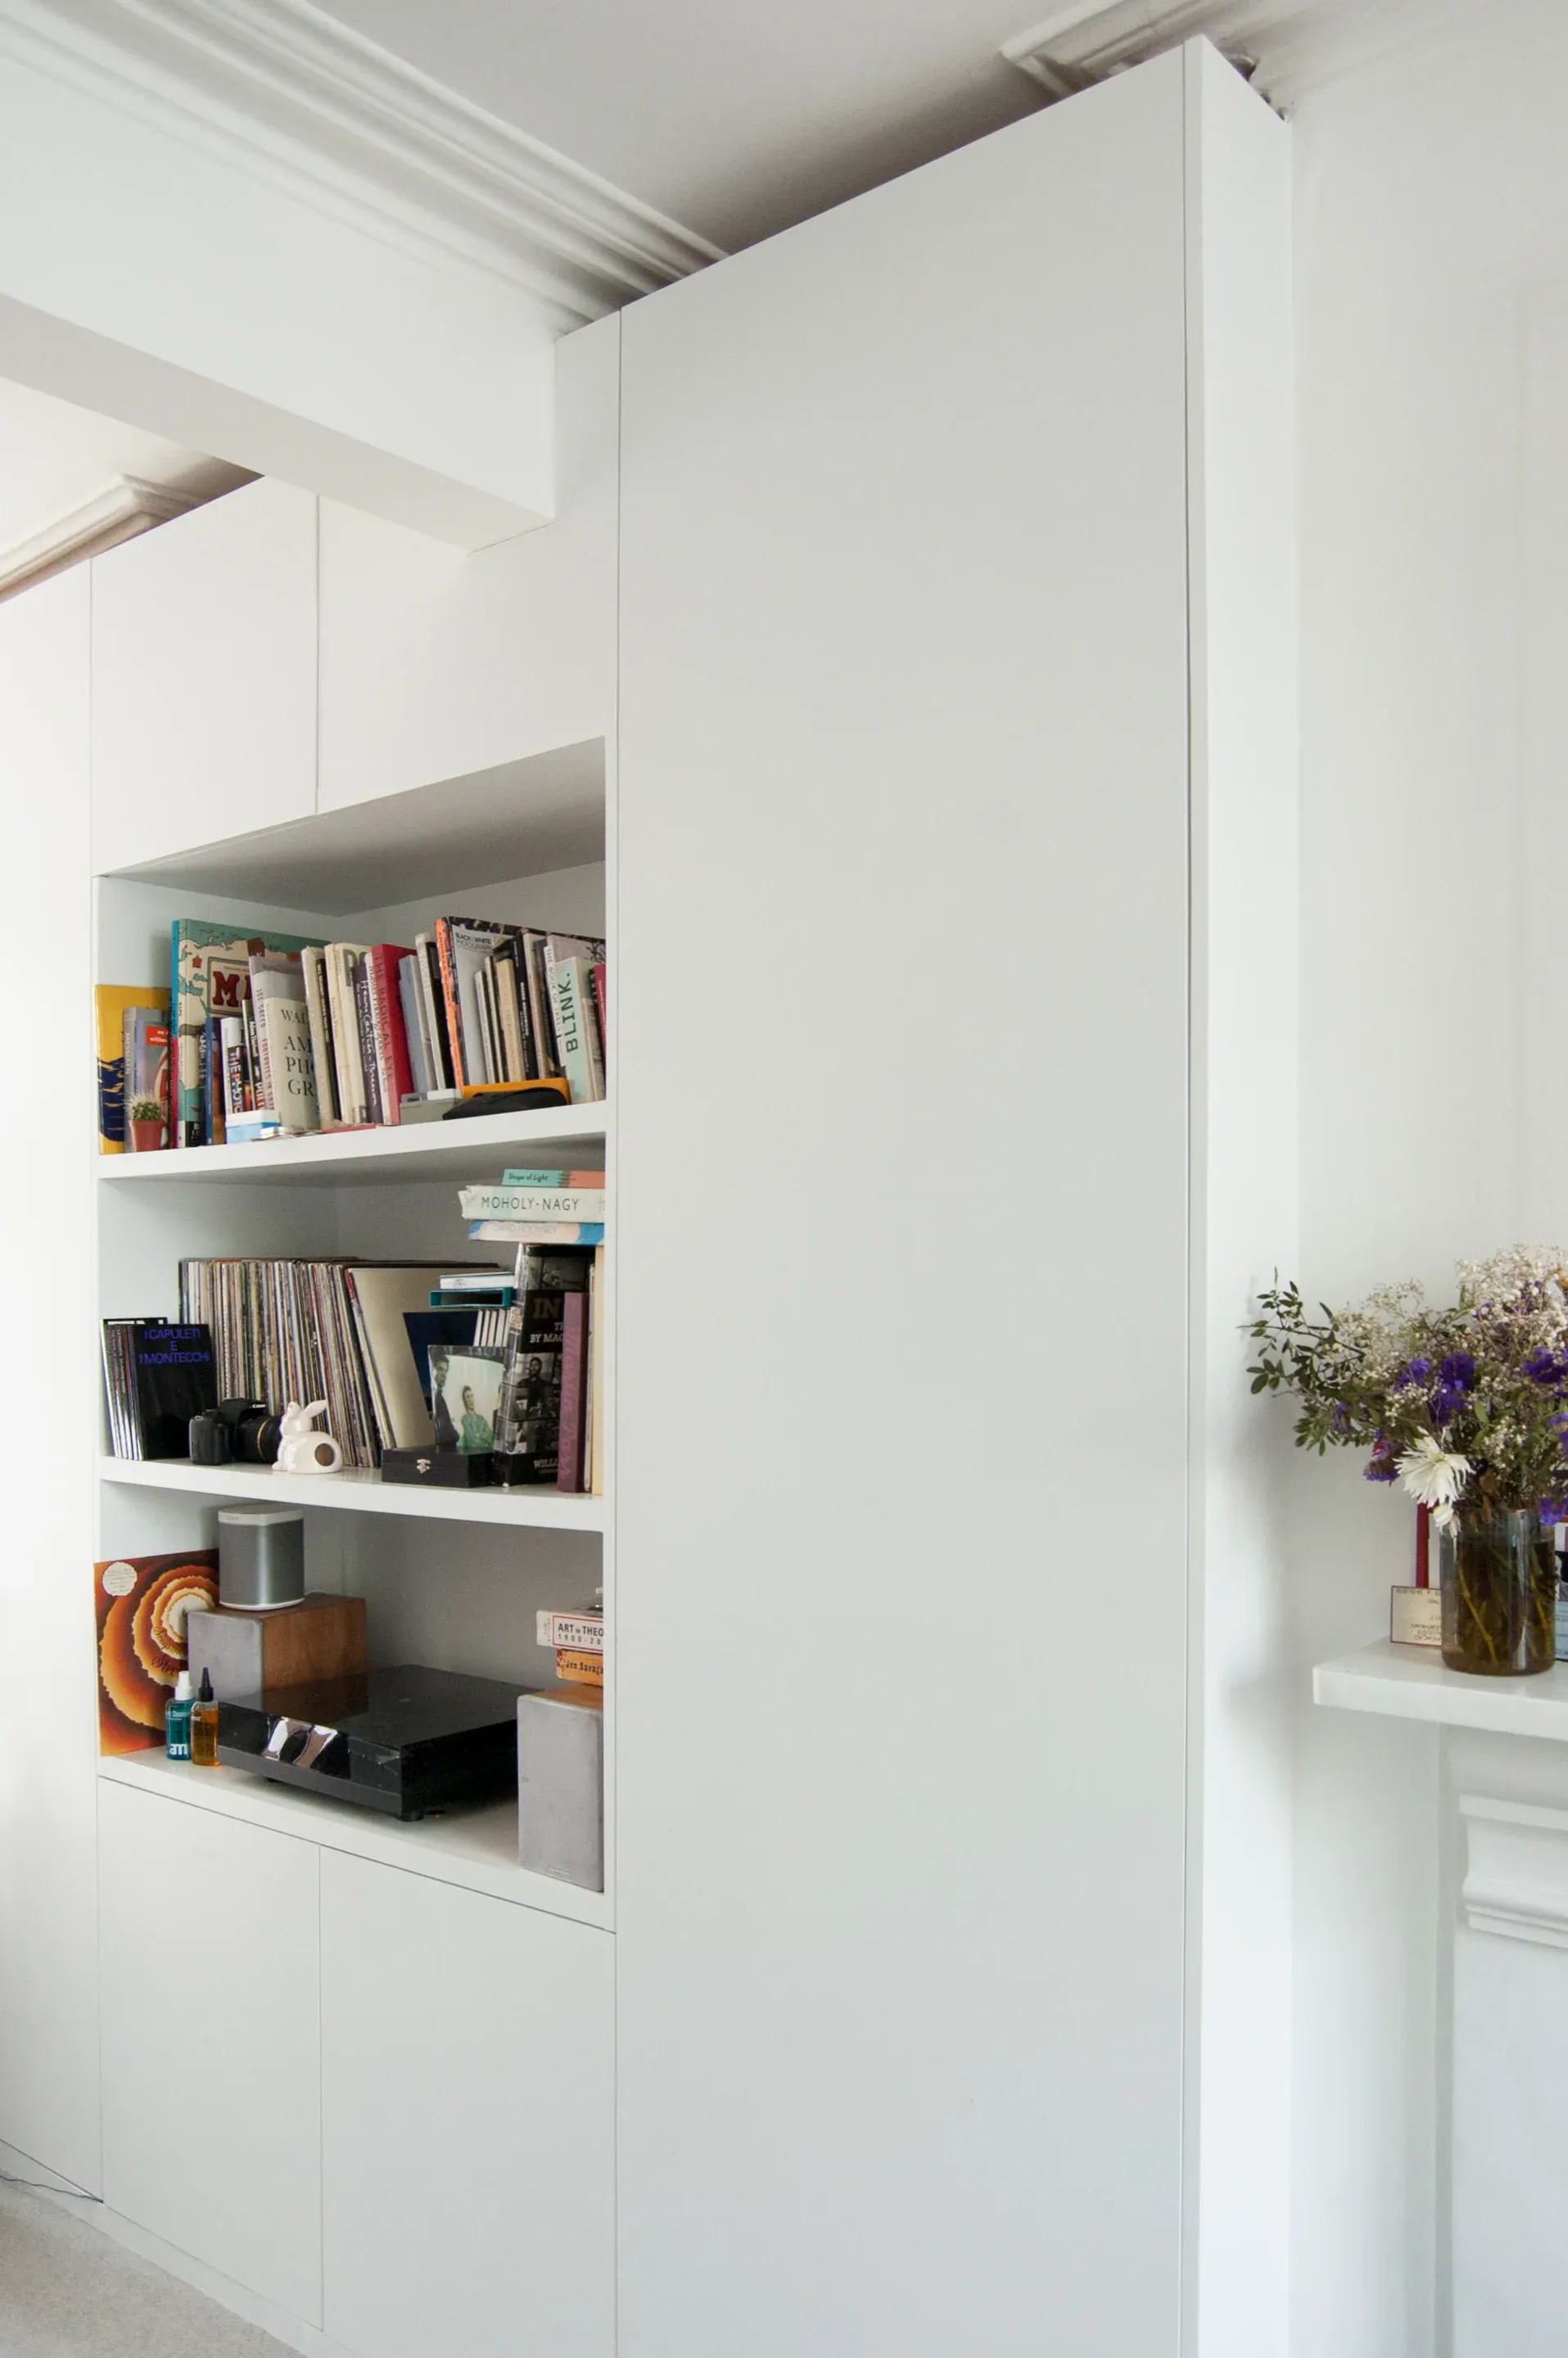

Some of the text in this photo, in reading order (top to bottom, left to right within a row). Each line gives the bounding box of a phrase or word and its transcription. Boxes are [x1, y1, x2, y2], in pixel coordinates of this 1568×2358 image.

[549, 967, 557, 990] BOOK
[374, 955, 395, 1082] THE RADICAL EYE
[228, 1047, 242, 1072] THE
[287, 1056, 315, 1075] PH
[508, 1173, 525, 1183] Shape
[534, 1174, 549, 1183] Light
[481, 1196, 580, 1211] MOHOLY-NAGY
[149, 1328, 201, 1339] CAPULETI
[531, 1334, 541, 1344] BY
[170, 1340, 178, 1352] E
[560, 1422, 577, 1480] Parr
[558, 1624, 574, 1633] ART
